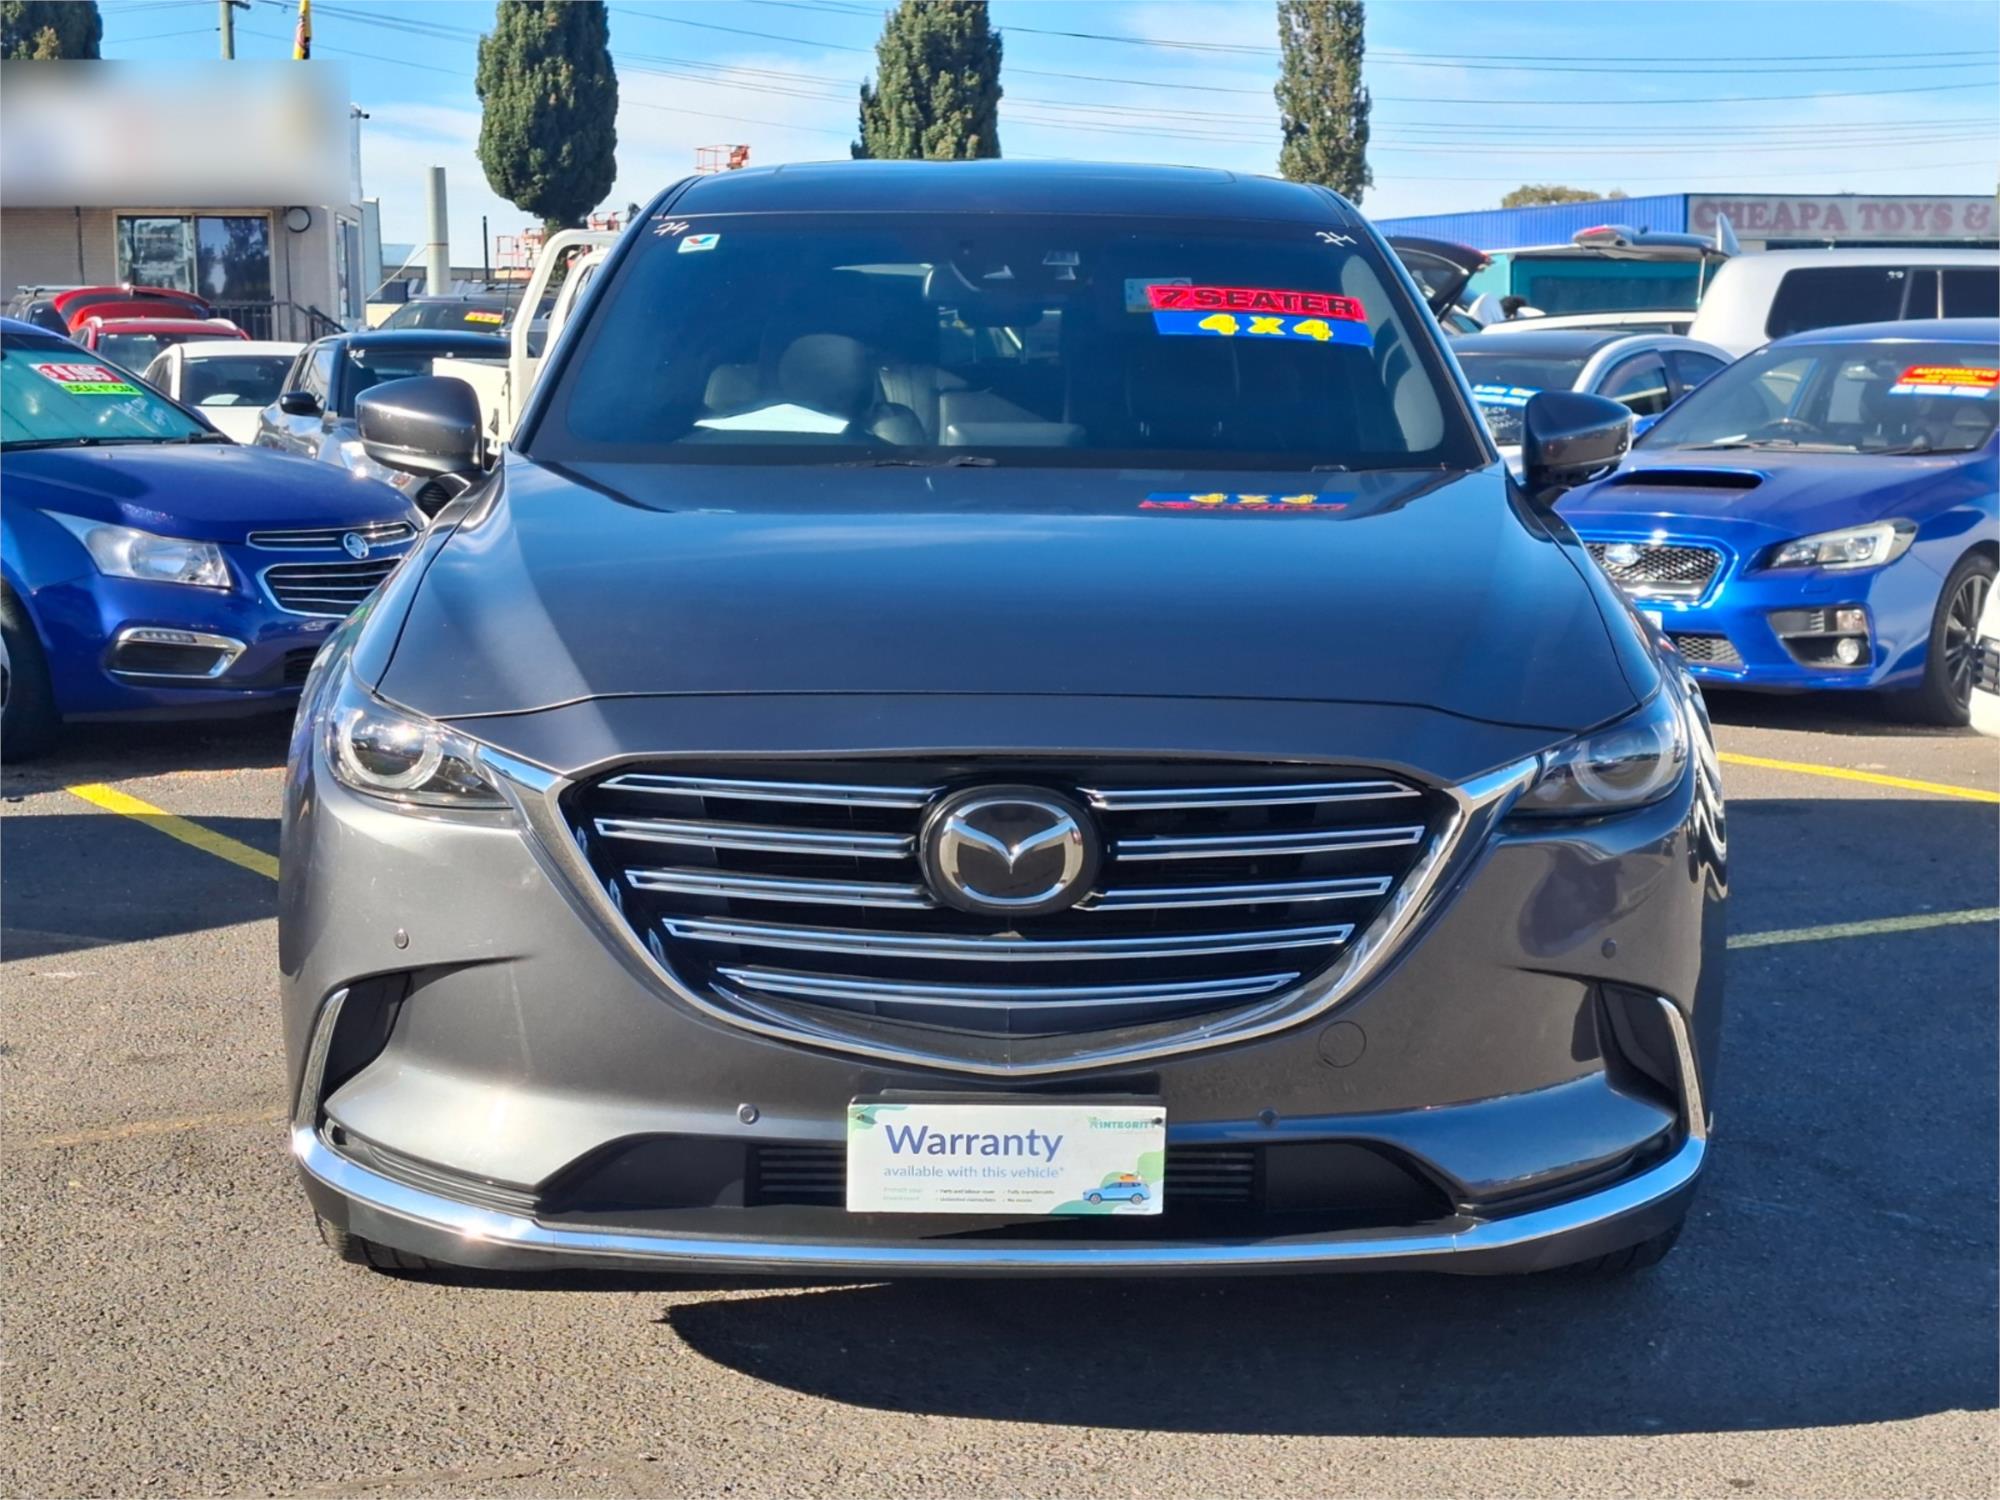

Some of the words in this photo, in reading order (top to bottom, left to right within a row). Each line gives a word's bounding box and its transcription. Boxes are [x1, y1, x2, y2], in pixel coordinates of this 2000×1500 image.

[1694, 202, 1848, 231] CHEAPA
[1858, 203, 1953, 231] TOYS
[1963, 203, 1992, 231] &
[1156, 288, 1185, 307] 7
[1194, 288, 1356, 314] SEATER
[885, 1125, 1064, 1162] Warranty
[883, 1166, 943, 1178] available
[947, 1166, 978, 1178] with
[982, 1166, 1007, 1178] this
